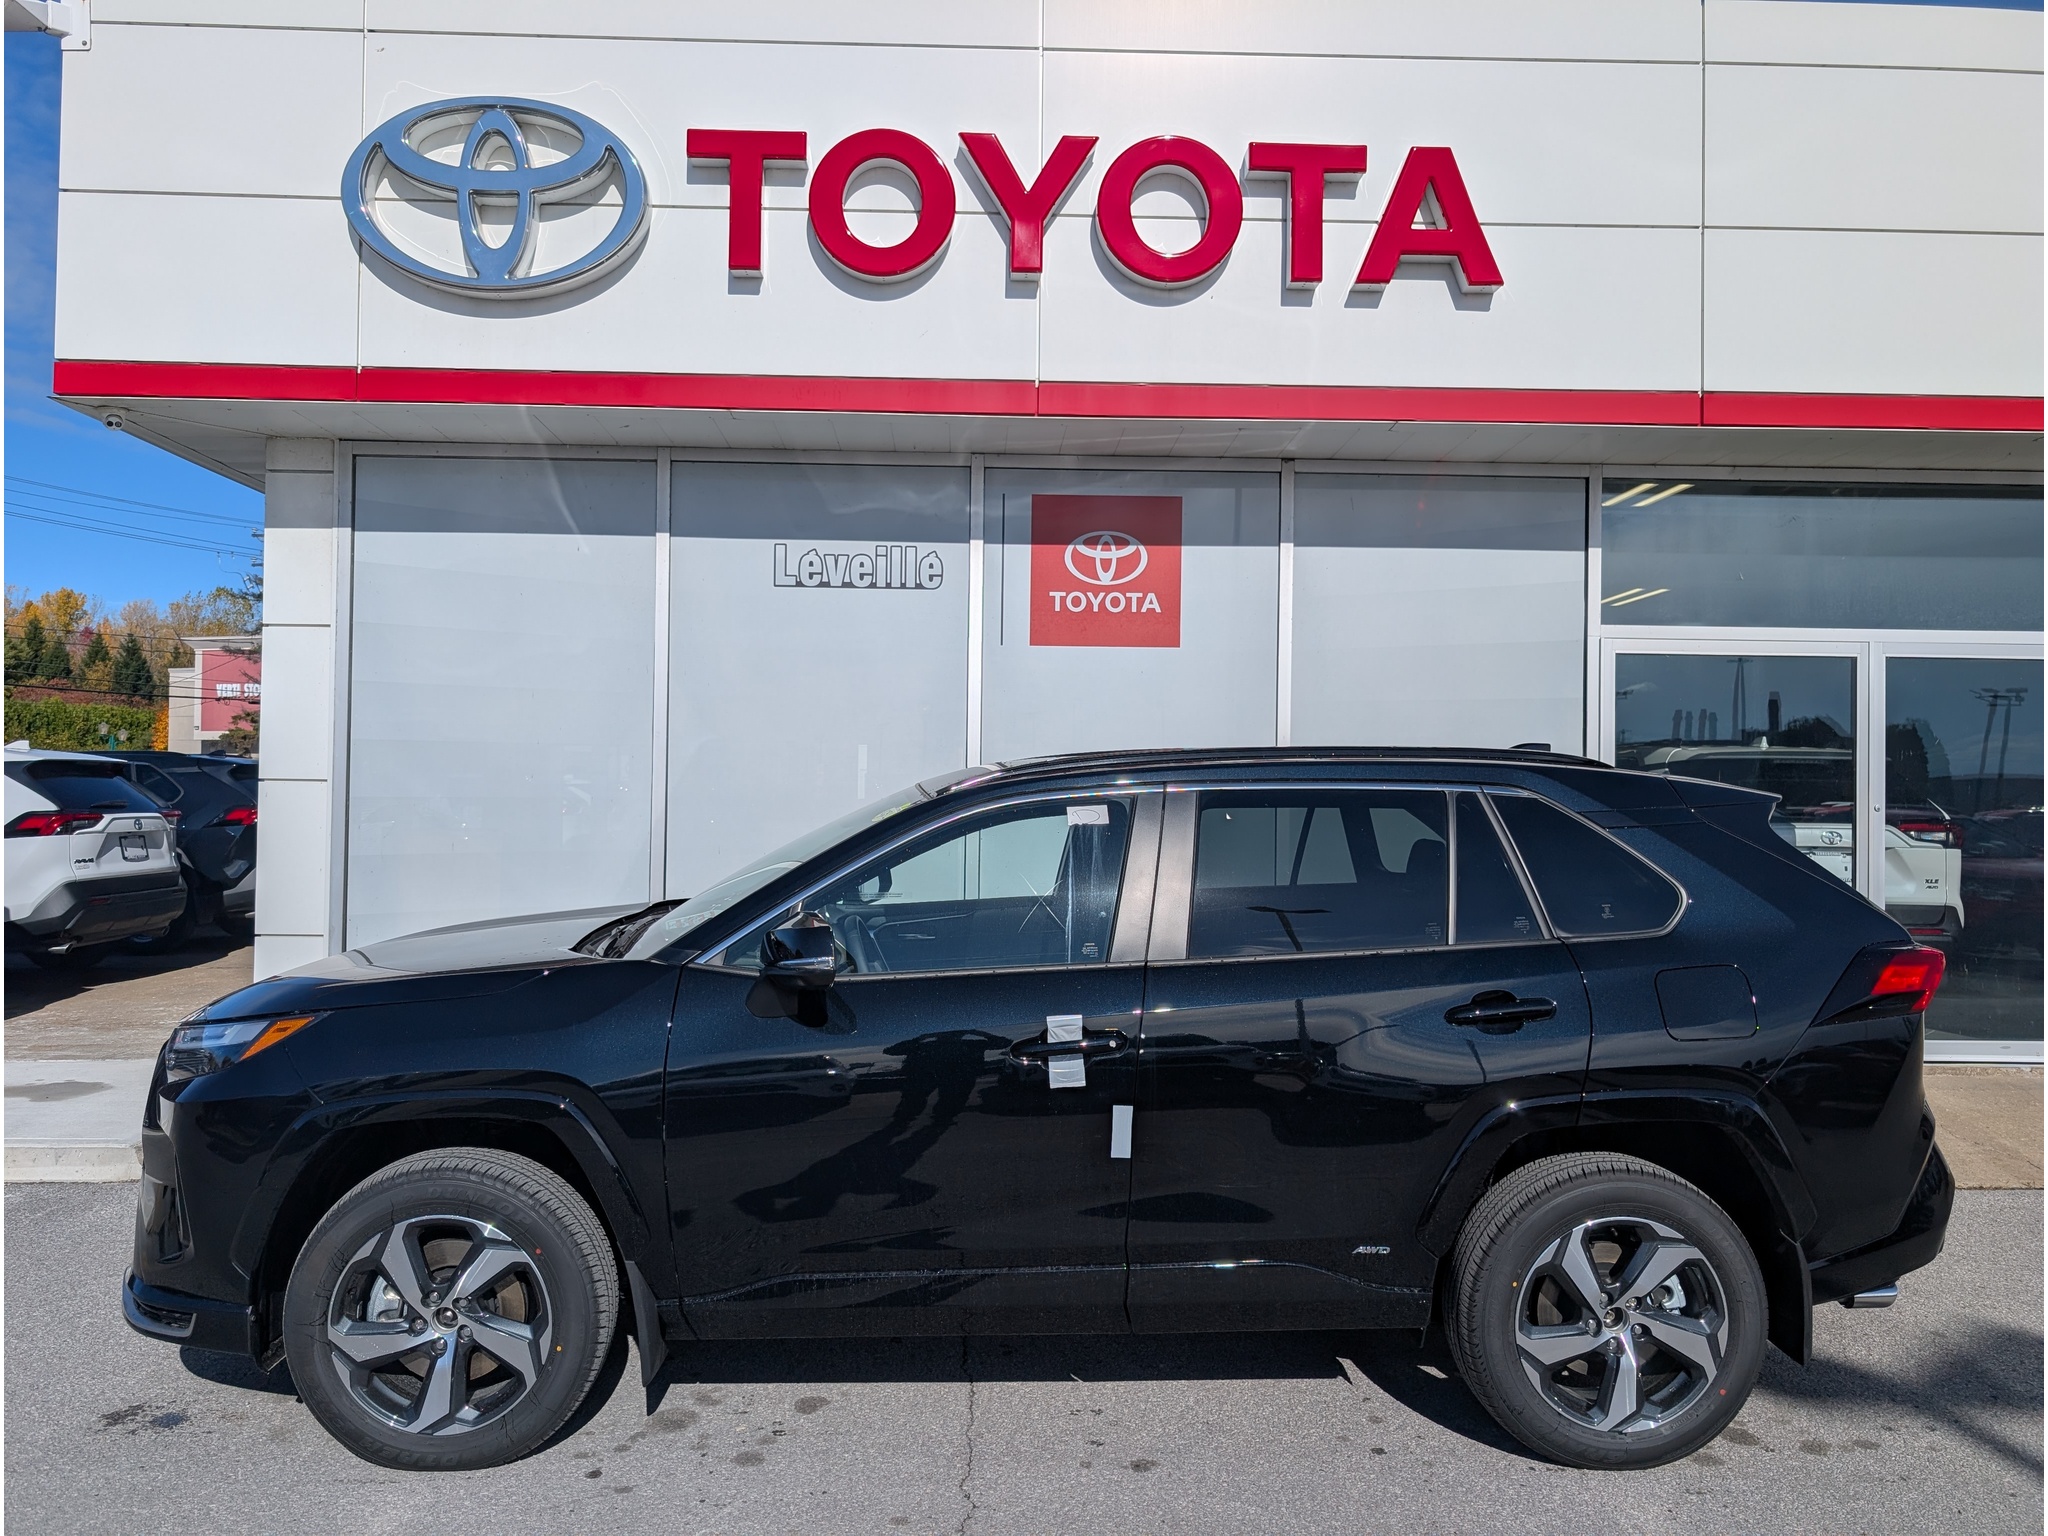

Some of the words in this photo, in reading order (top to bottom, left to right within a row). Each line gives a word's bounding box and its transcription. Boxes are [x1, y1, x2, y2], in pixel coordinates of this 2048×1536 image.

[686, 127, 1504, 293] TOYOTA
[773, 543, 944, 590] Léveillé
[1049, 591, 1162, 613] TOYOTA
[1352, 1246, 1391, 1254] AWD
